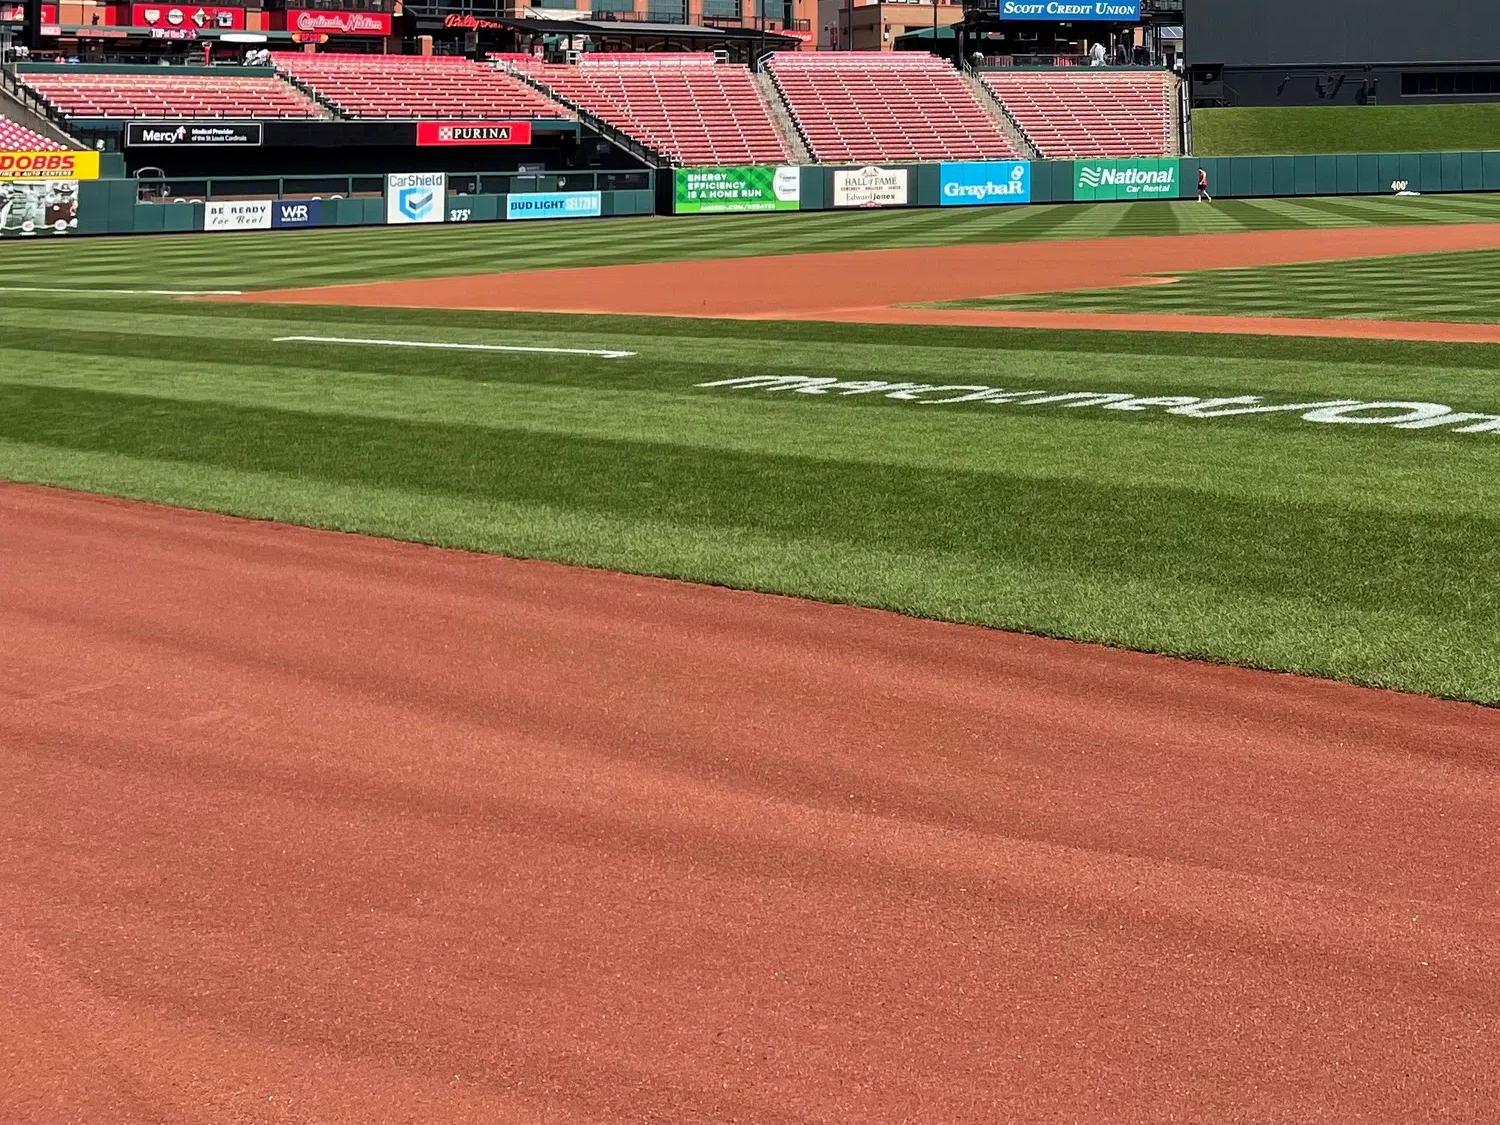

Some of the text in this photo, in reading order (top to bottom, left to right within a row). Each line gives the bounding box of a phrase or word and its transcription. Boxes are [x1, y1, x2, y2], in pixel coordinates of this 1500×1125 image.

[1004, 2, 1135, 14] SCOTT CREDIT UNION
[297, 12, 382, 31] Cardinals Nation
[445, 14, 480, 30] Bally
[143, 130, 177, 143] Mercy
[455, 127, 509, 139] PURINA
[0, 155, 75, 170] DOBBS
[390, 174, 443, 187] CarShield
[687, 181, 746, 189] EFFICIENCY
[845, 177, 867, 186] HALL
[875, 177, 897, 185] FAME
[1391, 180, 1408, 190] 400'
[688, 189, 762, 199] IS A HOME RUN
[1126, 184, 1170, 193] Car Rental
[231, 206, 266, 214] READY
[511, 202, 533, 210] BUD
[534, 200, 565, 210] LIGHT
[212, 216, 263, 225] for Real
[450, 209, 471, 221] 375'
